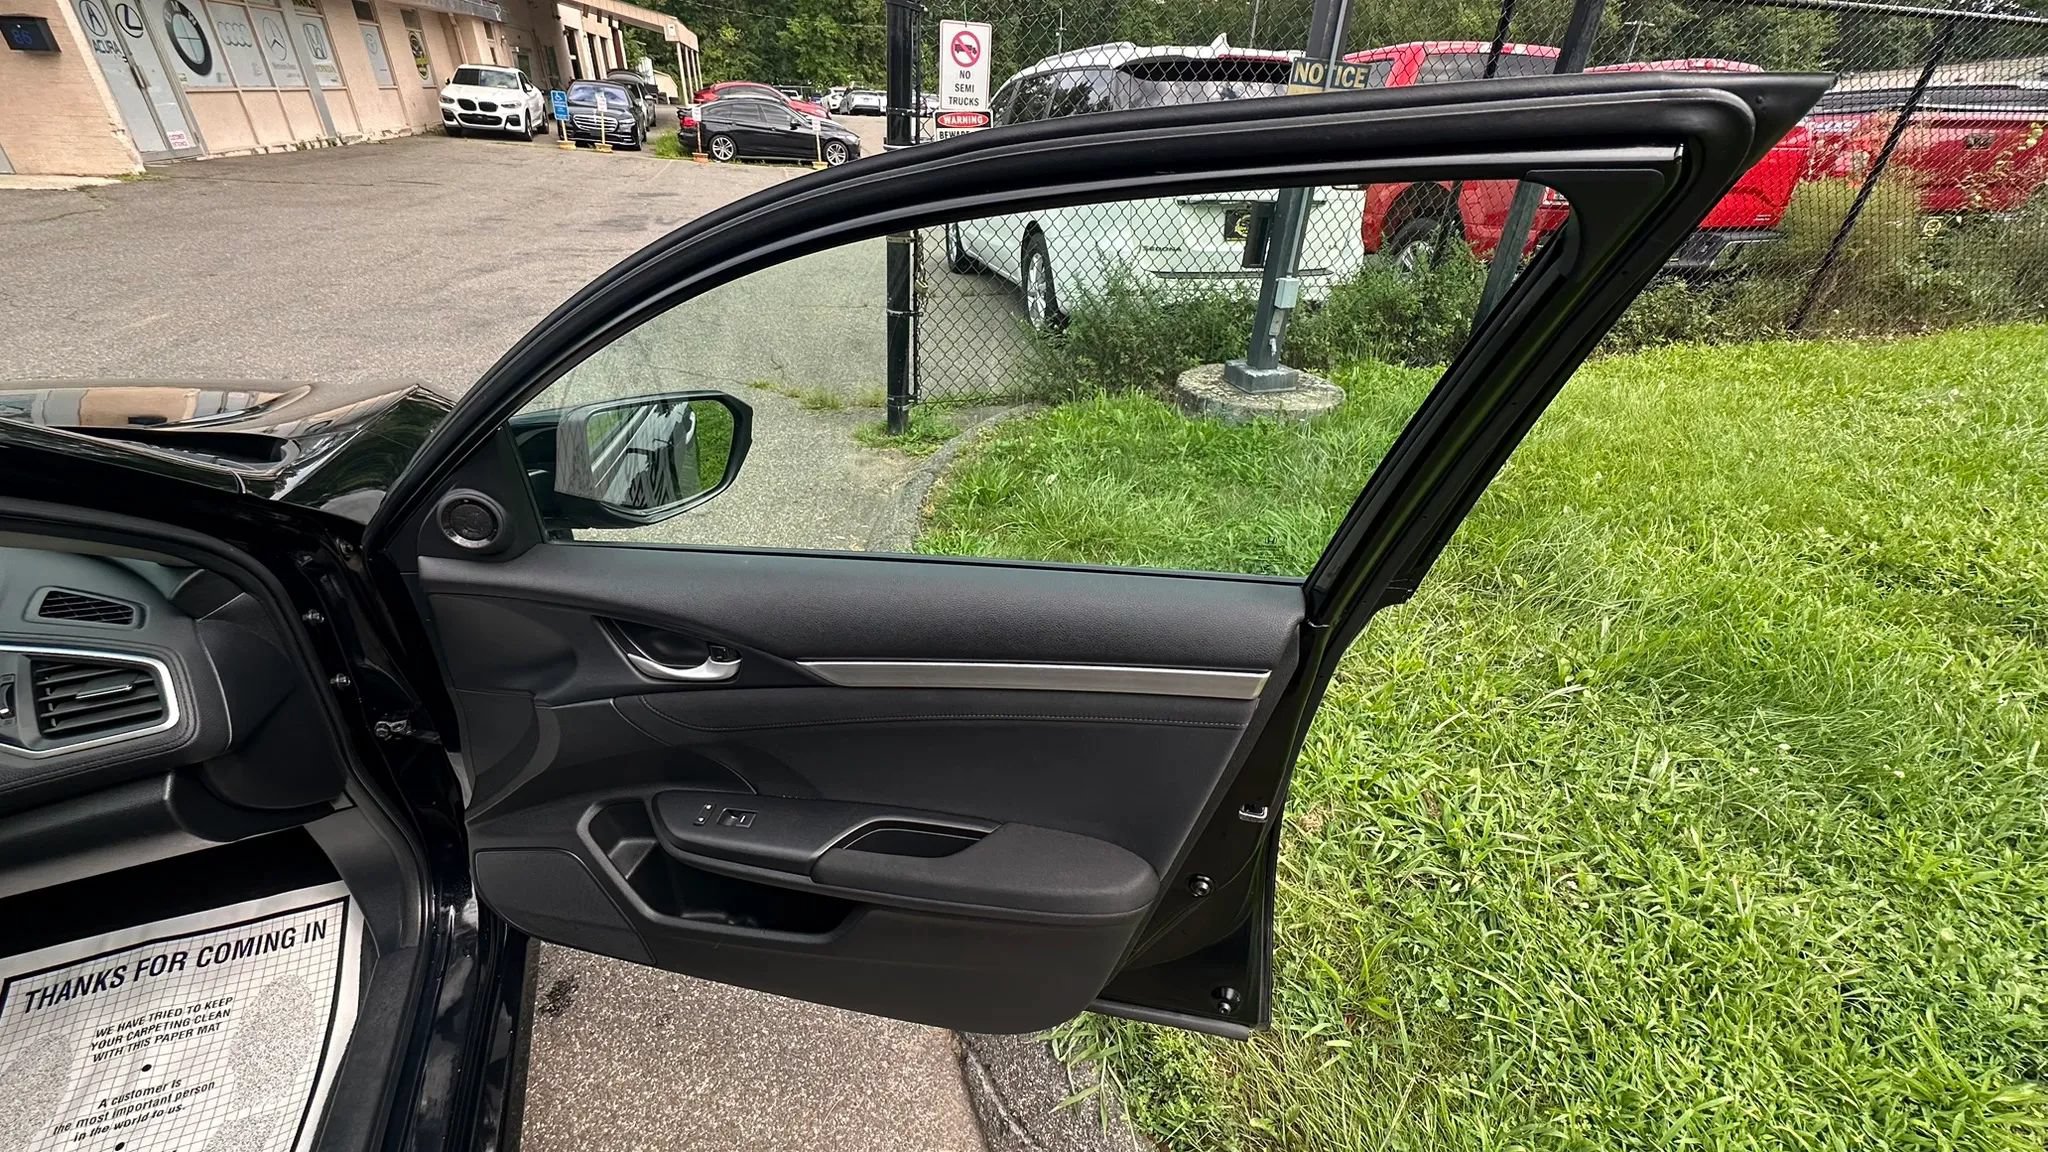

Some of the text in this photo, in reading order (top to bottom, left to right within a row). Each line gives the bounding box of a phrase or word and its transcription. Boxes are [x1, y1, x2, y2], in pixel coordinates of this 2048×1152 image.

[954, 83, 975, 93] SEMI
[959, 70, 971, 80] NO
[1293, 61, 1369, 89] NOICE
[948, 96, 980, 106] TRUCKS
[943, 115, 983, 125] WARNING
[939, 130, 970, 140] BEWA
[24, 919, 327, 1014] THANKS FOR COMING IN
[90, 1008, 231, 1051] YOUR CARPETING CLEAN
[95, 997, 233, 1038] WE HAVE TRIED TO KEEP
[92, 1022, 223, 1063] WITH THIS PAPER MAT
[53, 1081, 215, 1135] the most important person
[97, 1100, 108, 1109] A
[111, 1083, 170, 1106] customer
[73, 1103, 186, 1143] in the world to us.
